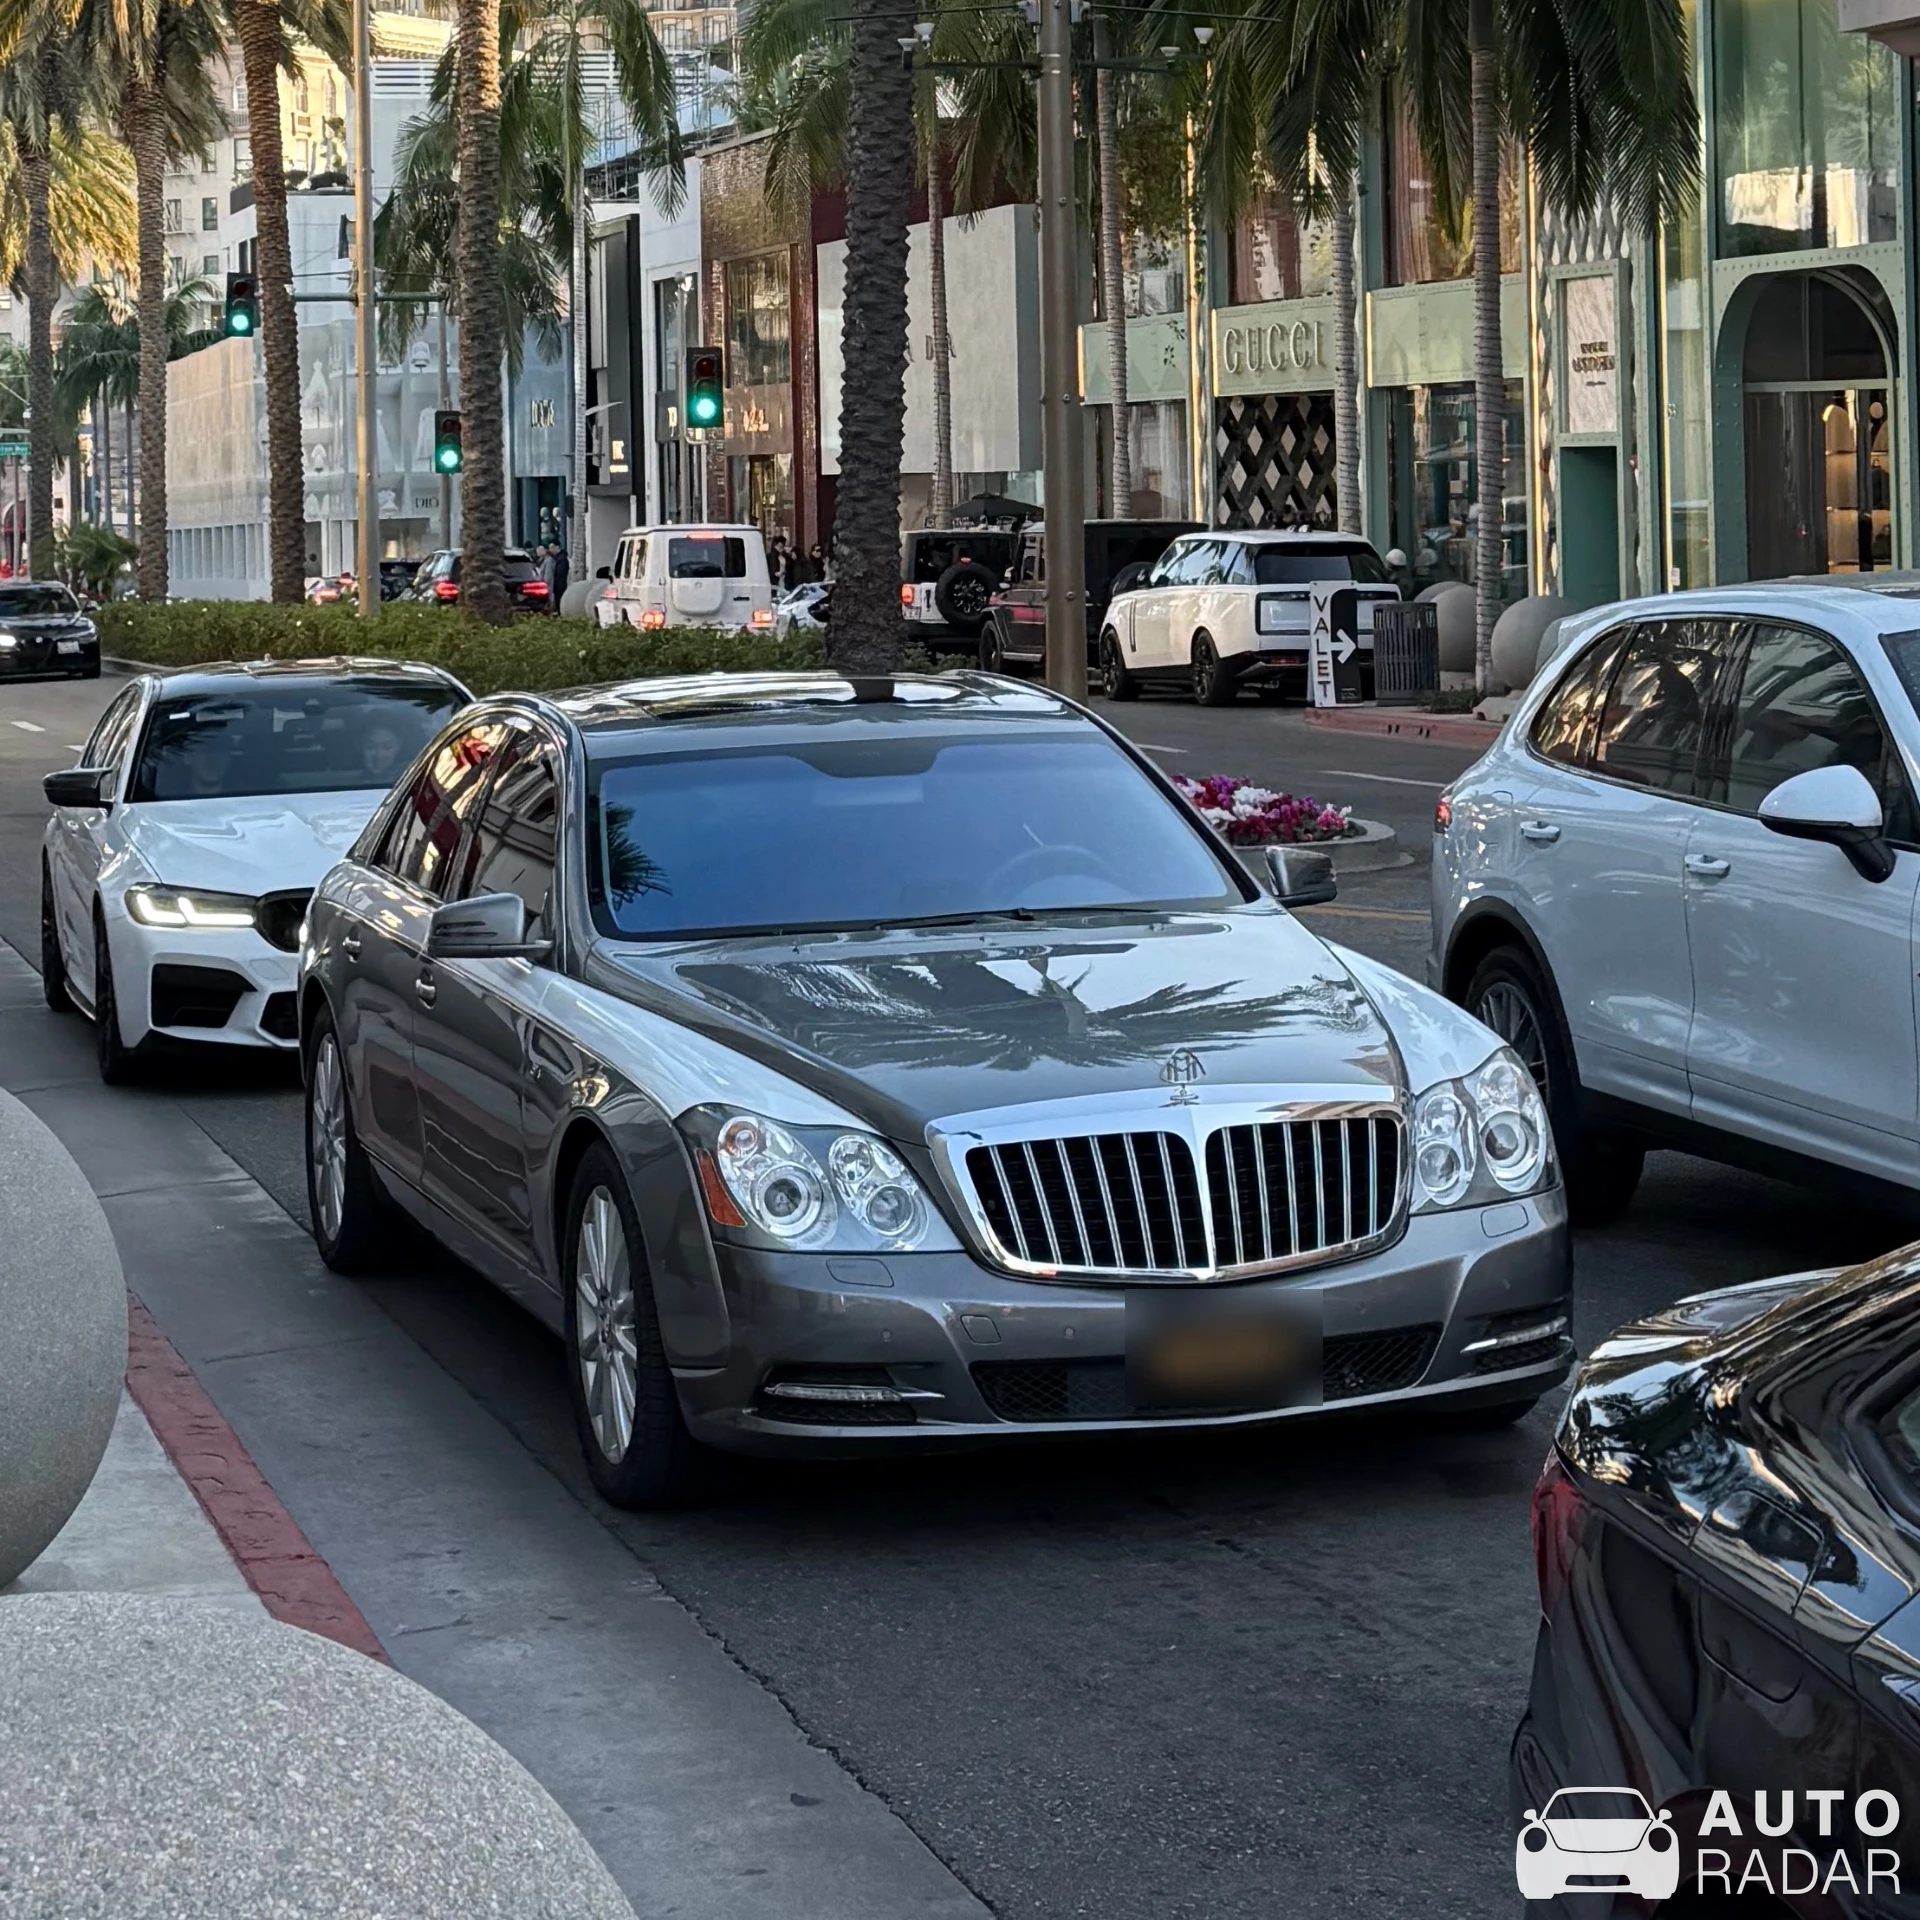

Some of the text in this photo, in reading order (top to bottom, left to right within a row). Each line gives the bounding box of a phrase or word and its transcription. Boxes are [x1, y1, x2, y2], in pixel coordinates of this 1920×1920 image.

[1223, 321, 1319, 373] GUCCI
[415, 496, 440, 508] DIO
[1313, 595, 1331, 698] VALET
